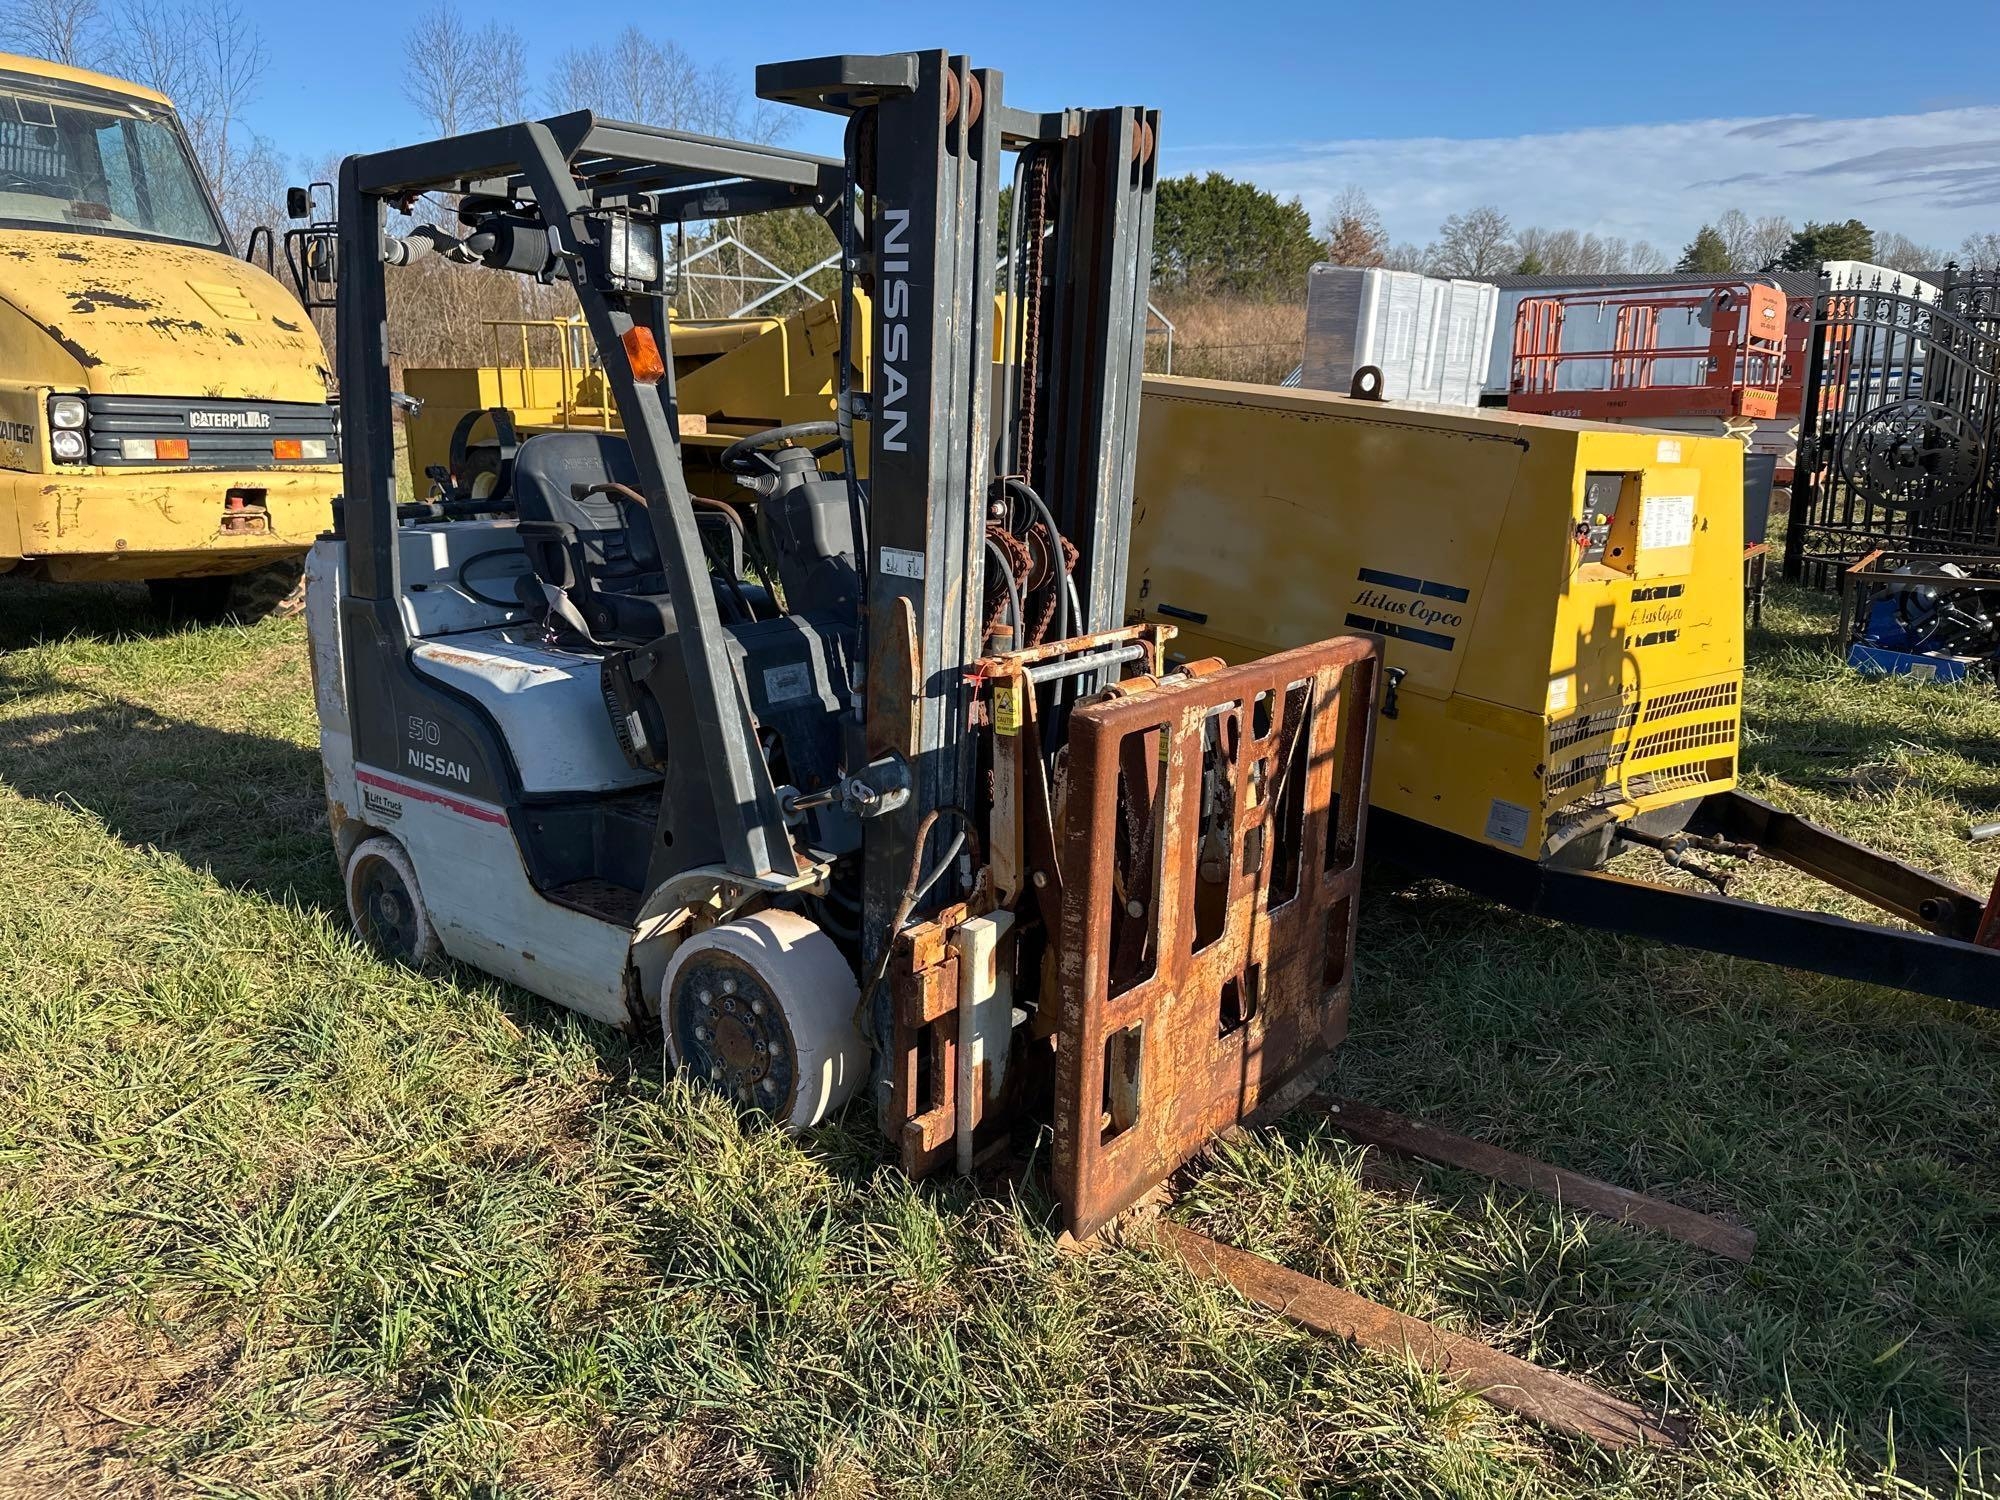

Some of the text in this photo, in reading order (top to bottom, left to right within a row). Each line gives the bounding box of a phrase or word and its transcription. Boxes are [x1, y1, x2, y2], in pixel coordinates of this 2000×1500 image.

[882, 208, 911, 453] NISSAN
[0, 420, 35, 444] ANCEY
[1351, 589, 1463, 627] Atlas Copco
[408, 715, 441, 746] 50
[407, 748, 471, 783] NISSAN
[370, 792, 383, 805] Lift
[383, 797, 403, 811] Truck
